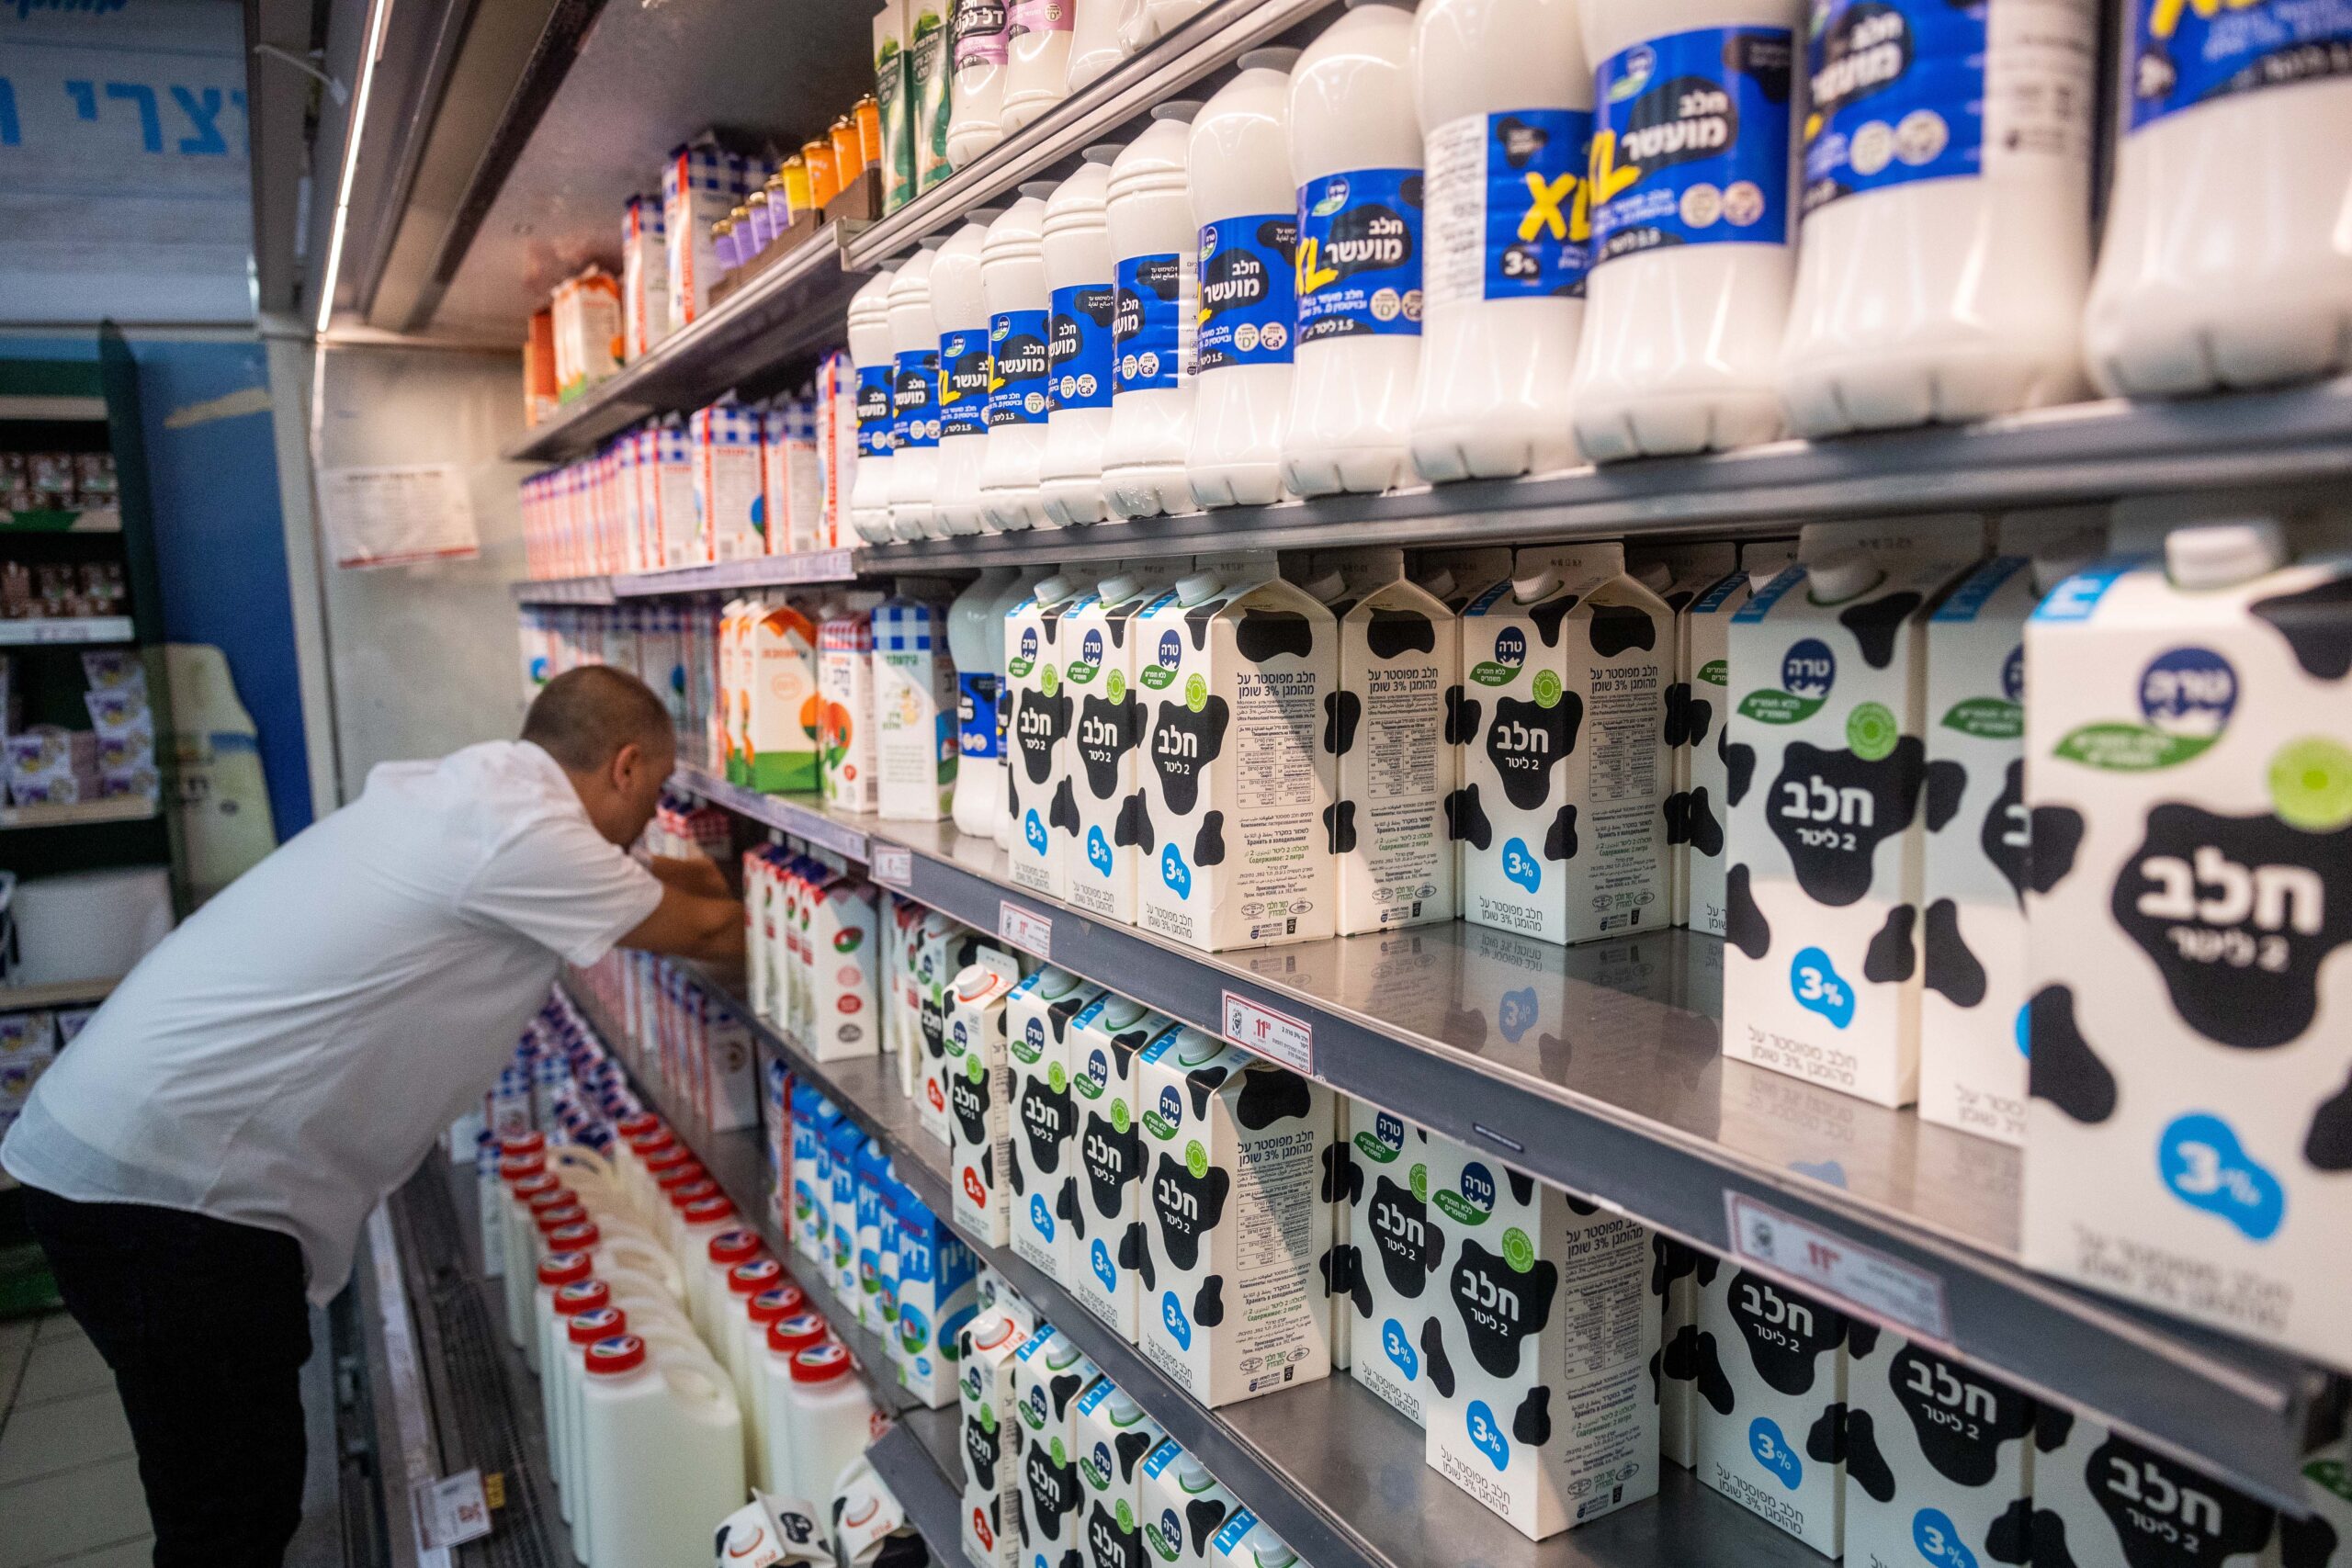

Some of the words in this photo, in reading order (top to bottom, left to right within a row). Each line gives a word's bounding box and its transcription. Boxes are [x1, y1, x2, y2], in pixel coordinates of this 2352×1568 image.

[956, 8, 982, 34] לקט
[983, 10, 1003, 26] דל
[64, 78, 248, 156] צרי
[1621, 117, 1727, 162] מועשר
[1369, 217, 1403, 236] חלב
[1324, 240, 1403, 265] מועשר
[1231, 261, 1260, 276] חלב
[1204, 279, 1260, 304] מועשר
[1113, 313, 1139, 336] מועש
[1339, 319, 1354, 332] 1.5
[1265, 334, 1281, 348] Ca
[998, 356, 1046, 375] מועשר
[1212, 352, 1223, 363] 1.5
[952, 369, 988, 389] ועשר
[1085, 642, 1101, 653] טרה
[1160, 644, 1179, 656] טרה
[1498, 640, 1522, 653] טרה
[1296, 671, 1316, 683] חלב
[1367, 669, 1381, 682] על
[1384, 670, 1419, 680] מפוסטר
[1421, 667, 1439, 679] חלב
[1590, 668, 1603, 681] על
[1605, 668, 1640, 680] מפוסטר
[1642, 665, 1658, 677] חלב
[1787, 658, 1831, 679] טרה
[1237, 672, 1251, 685] על
[1254, 673, 1294, 684] מפוסטר
[1393, 682, 1407, 691] 3%
[1409, 679, 1437, 693] מהומגן
[1591, 681, 1612, 694] שומן
[1614, 680, 1628, 691] 3%
[1630, 678, 1657, 692] מהומגן
[1239, 686, 1261, 699] שומן
[1264, 685, 1280, 696] 3%
[1283, 684, 1315, 698] מהומגן
[1369, 682, 1391, 695] שומן
[1020, 707, 1052, 737] חלב
[1082, 716, 1117, 748] חלב
[1497, 720, 1549, 753] חלב
[1158, 725, 1198, 759] חלב
[1088, 750, 1105, 761] ליטר
[1104, 751, 1112, 762] 2
[1505, 756, 1530, 770] ליטר
[1164, 761, 1182, 774] ליטר
[1183, 764, 1190, 775] 2
[1532, 759, 1539, 771] 2
[1781, 774, 1874, 828] חלב
[1028, 820, 1044, 842] 3%
[1796, 828, 1839, 849] ליטר
[1091, 839, 1108, 863] 3%
[1247, 838, 1268, 847] Хранить
[1272, 846, 1285, 854] ליטר
[1846, 835, 1858, 852] 2
[1249, 855, 1284, 864] Содержимое:
[1290, 853, 1305, 862] литра
[1508, 852, 1533, 877] 3%
[1166, 857, 1185, 884] 3%
[2136, 844, 2325, 937] חלב
[1479, 896, 1490, 908] על
[1492, 900, 1523, 917] מפוסטר
[1481, 908, 1498, 921] שומן
[1500, 913, 1513, 925] 3%
[1525, 907, 1544, 921] חלב
[1514, 917, 1542, 931] מהומגן
[1798, 965, 1844, 1008] 3%
[1090, 1059, 1106, 1075] טרה
[1025, 1096, 1059, 1131] חלב
[1162, 1097, 1180, 1113] טרה
[1296, 1131, 1314, 1143] חלב
[1379, 1118, 1401, 1138] טרה
[1238, 1142, 1251, 1154] על
[1254, 1134, 1294, 1150] מפוסטר
[1282, 1142, 1313, 1157] מהומגן
[1087, 1134, 1122, 1173] חלב
[1239, 1153, 1261, 1168] שומן
[1265, 1150, 1280, 1160] 3%
[1363, 1144, 1382, 1159] משמרים
[1091, 1164, 1108, 1182] ליטר
[1109, 1174, 1115, 1185] 2
[1464, 1175, 1492, 1197] טרה
[1159, 1179, 1198, 1221] חלב
[1440, 1193, 1460, 1208] חומרים
[1461, 1203, 1473, 1215] ללא
[1034, 1204, 1050, 1230] 3%
[1444, 1203, 1467, 1221] משמרים
[1164, 1212, 1183, 1231] ליטר
[1184, 1222, 1191, 1235] 2
[1376, 1202, 1425, 1247] חלב
[1584, 1220, 1623, 1240] מפוסטר
[1384, 1236, 1407, 1256] ליטר
[1566, 1230, 1581, 1245] על
[1594, 1236, 1610, 1251] 3%
[1612, 1226, 1644, 1248] מהומגן
[1408, 1248, 1416, 1261] 2
[1567, 1240, 1591, 1259] שומן
[1095, 1250, 1112, 1278] 3%
[1461, 1268, 1521, 1323] חלב
[1470, 1306, 1497, 1331] ליטר
[1741, 1283, 1814, 1338] חלב
[1167, 1304, 1185, 1336] 3%
[1499, 1321, 1509, 1337] 2
[1753, 1323, 1787, 1347] ליטר
[1388, 1332, 1411, 1364] 3%
[1790, 1337, 1801, 1352] 2
[1362, 1359, 1373, 1377] על
[1373, 1370, 1403, 1399] מפוסטר
[1906, 1358, 1998, 1425] חלב
[1403, 1392, 1420, 1412] חלב
[1920, 1403, 1962, 1433] ליטר
[1473, 1416, 1501, 1452] 3%
[1966, 1424, 1980, 1441] 2
[1441, 1443, 1453, 1463] על
[1757, 1432, 1792, 1471] 3%
[1442, 1461, 1462, 1482] שומן
[1453, 1456, 1489, 1491] מפוסטר
[1716, 1461, 1731, 1482] על
[1030, 1459, 1060, 1503] חלב
[1464, 1474, 1477, 1493] 3%
[1718, 1480, 1743, 1500] שומן
[1734, 1472, 1778, 1507] מפוסטר
[1478, 1486, 1510, 1516] מהומגן
[1491, 1481, 1511, 1506] חלב
[2106, 1456, 2223, 1538] חלב
[1745, 1495, 1762, 1511] 3%
[1780, 1497, 1804, 1525] חלב
[1163, 1517, 1181, 1539] טרה
[1764, 1503, 1803, 1535] מהומגן
[2124, 1506, 2178, 1544] ליטר
[1092, 1521, 1126, 1567] חלב
[1923, 1525, 1967, 1568] 3%
[2183, 1531, 2200, 1554] 2
